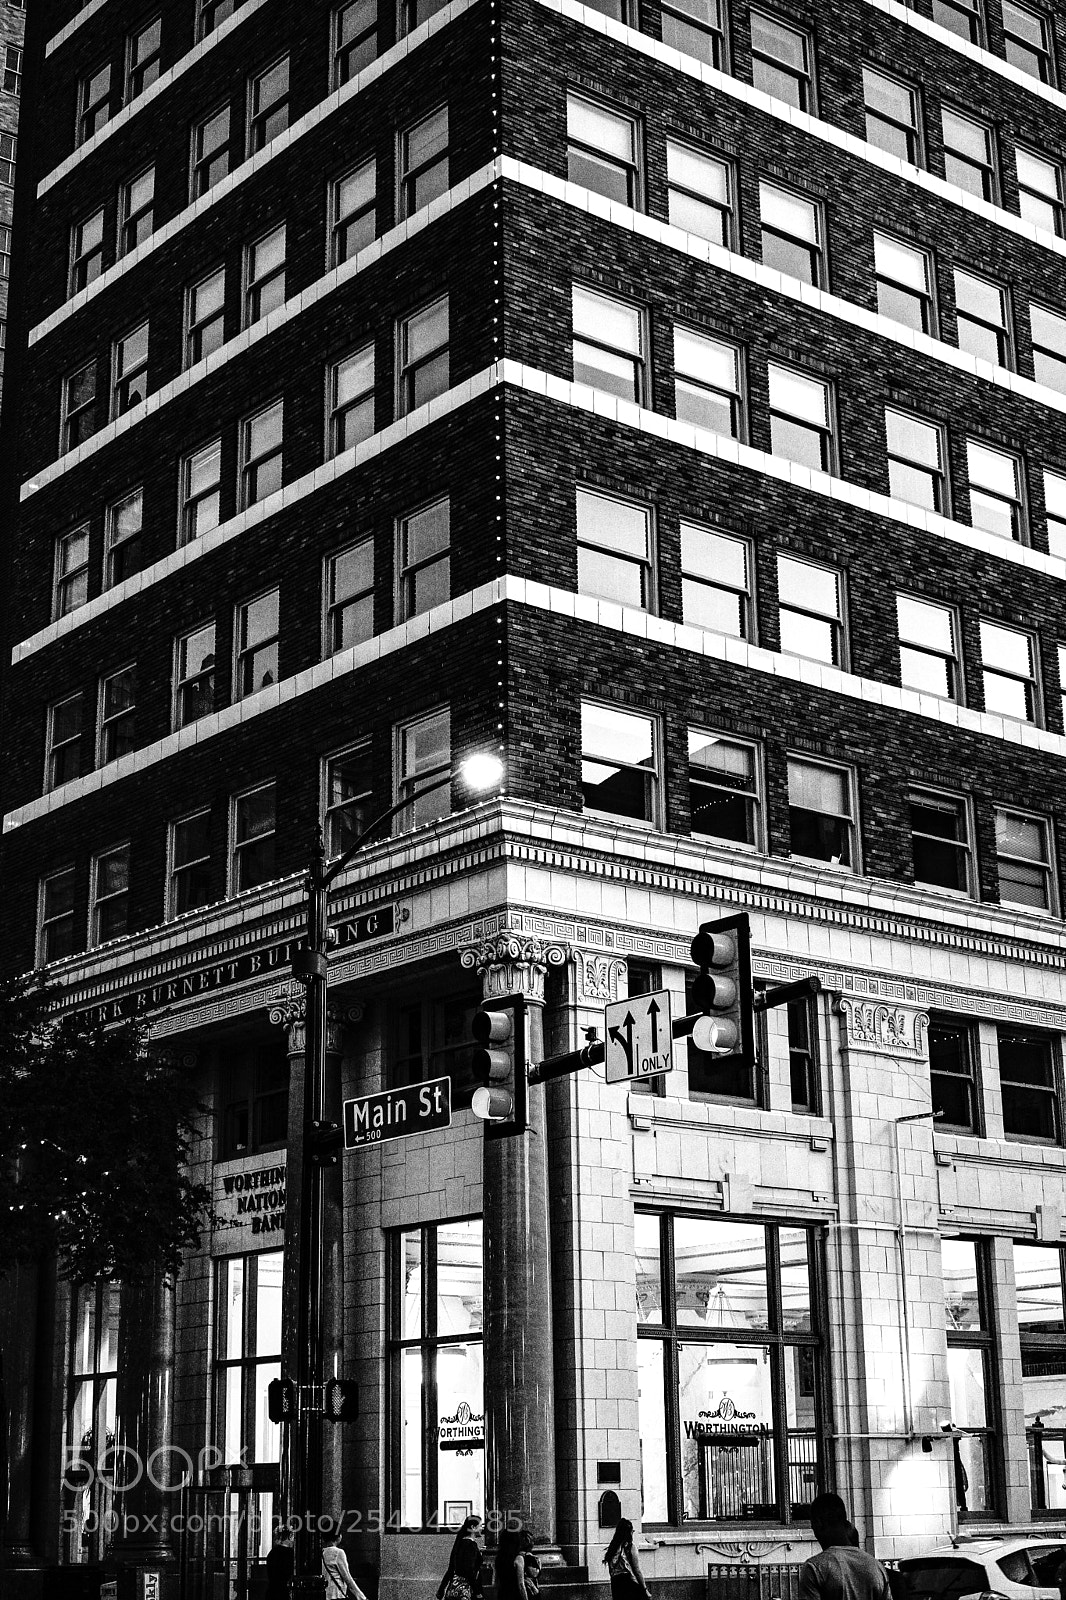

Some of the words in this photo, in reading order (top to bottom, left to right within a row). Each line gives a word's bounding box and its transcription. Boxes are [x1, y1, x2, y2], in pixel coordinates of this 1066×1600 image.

[137, 961, 239, 1008] BURNETT
[642, 1054, 669, 1071] ONLY
[353, 1095, 407, 1132] Main
[418, 1085, 442, 1117] St
[366, 1129, 382, 1140] 500
[684, 1420, 769, 1440] WORTHINGTON
